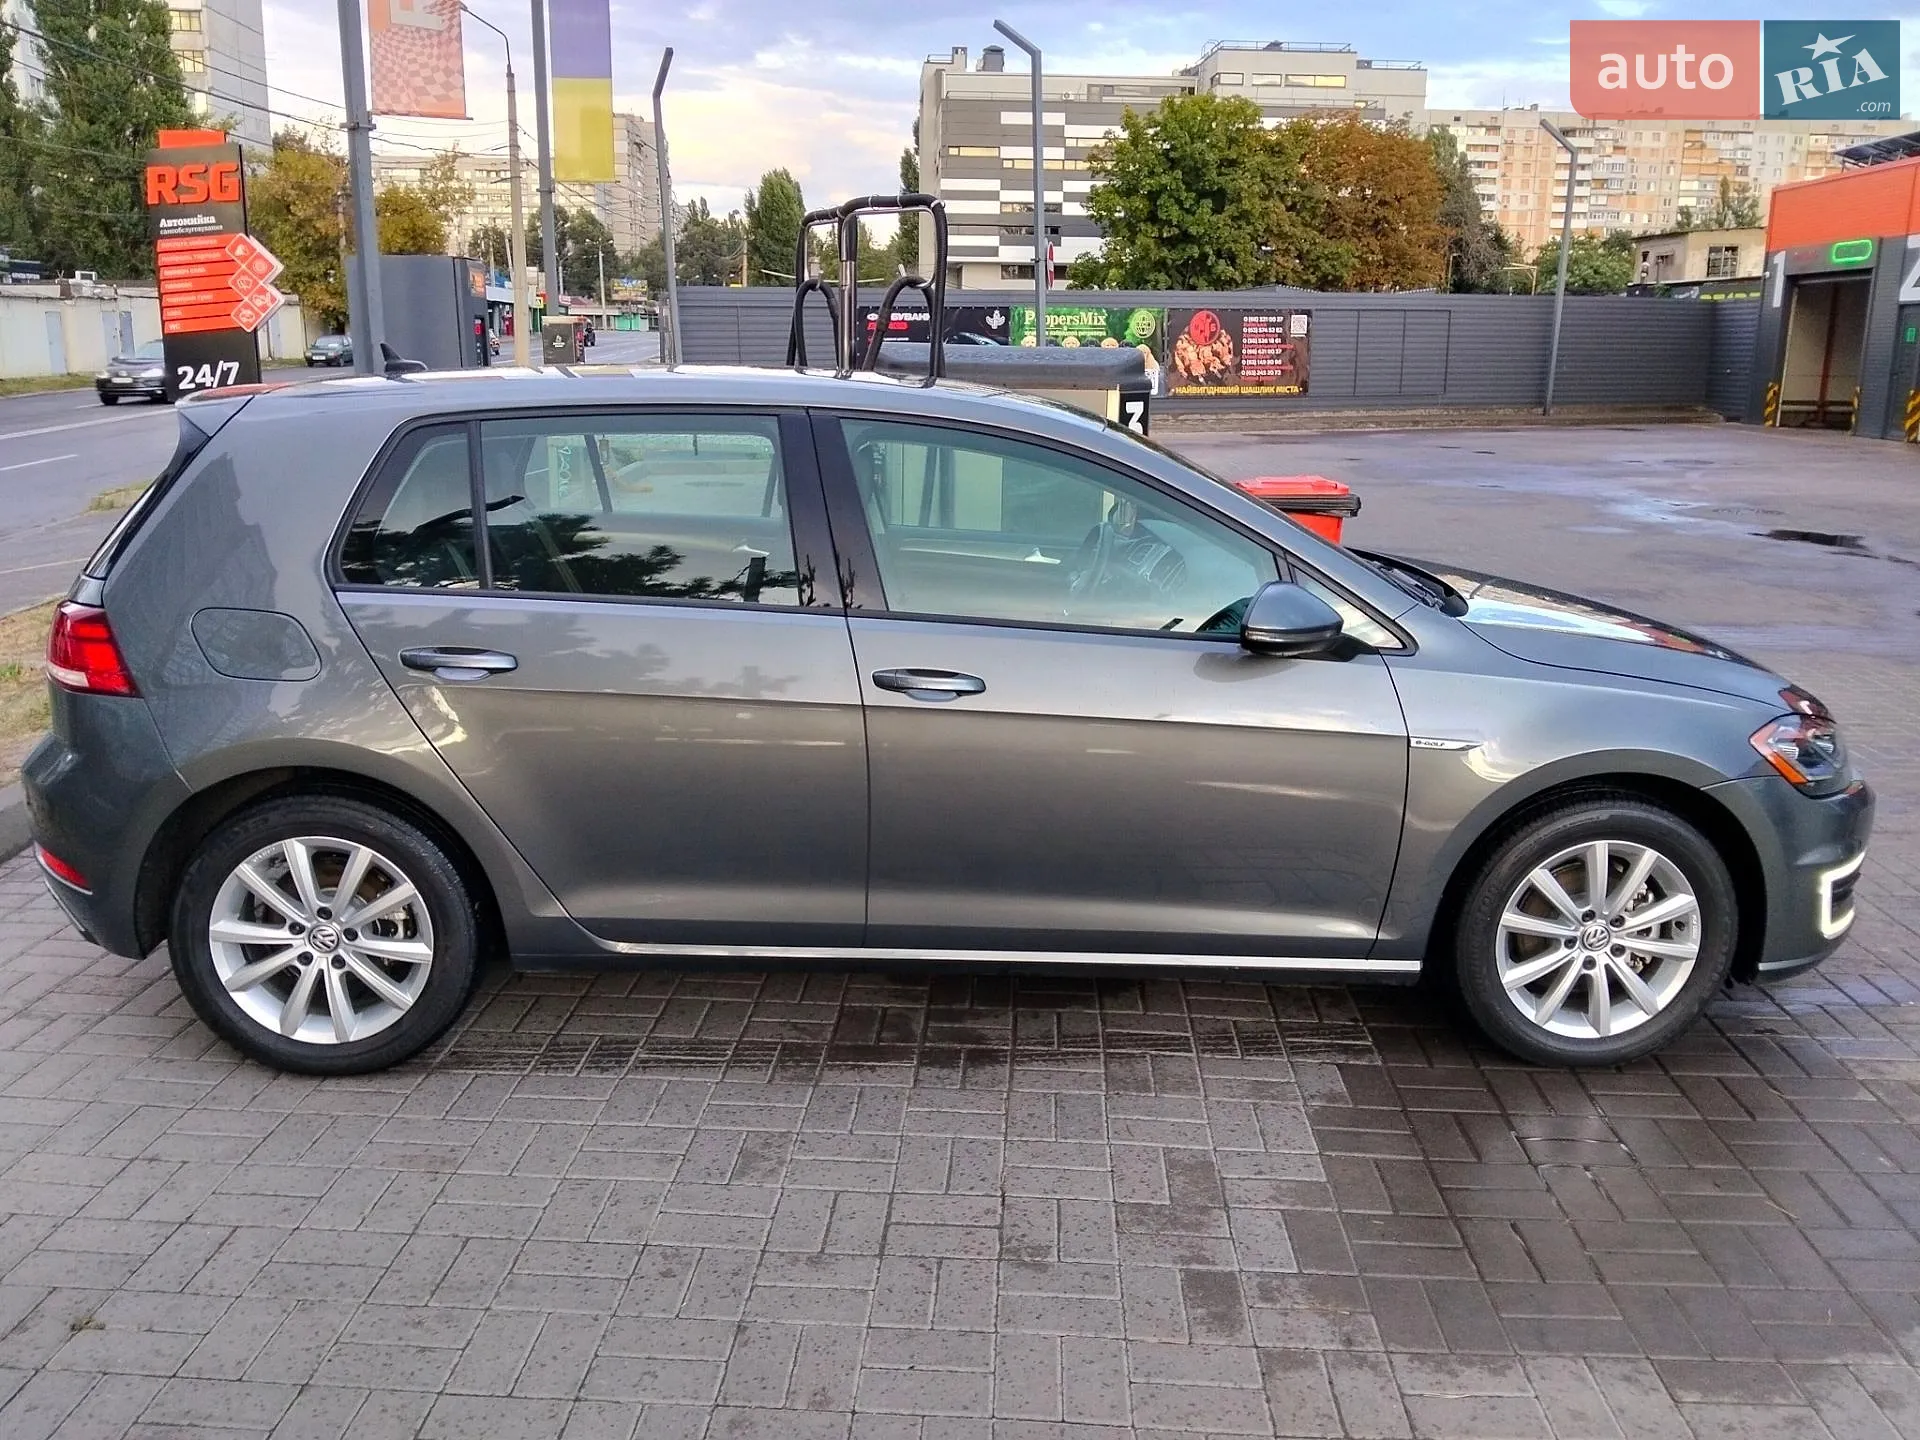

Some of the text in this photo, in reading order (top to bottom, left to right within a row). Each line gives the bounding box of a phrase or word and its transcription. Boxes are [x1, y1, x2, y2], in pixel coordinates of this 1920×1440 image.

[146, 163, 240, 205] RSG
[1773, 251, 1786, 308] 1
[1024, 310, 1107, 328] PppersMix
[177, 360, 240, 389] 24/7
[1240, 386, 1275, 395] ШАШЛИК
[1125, 401, 1144, 435] 3
